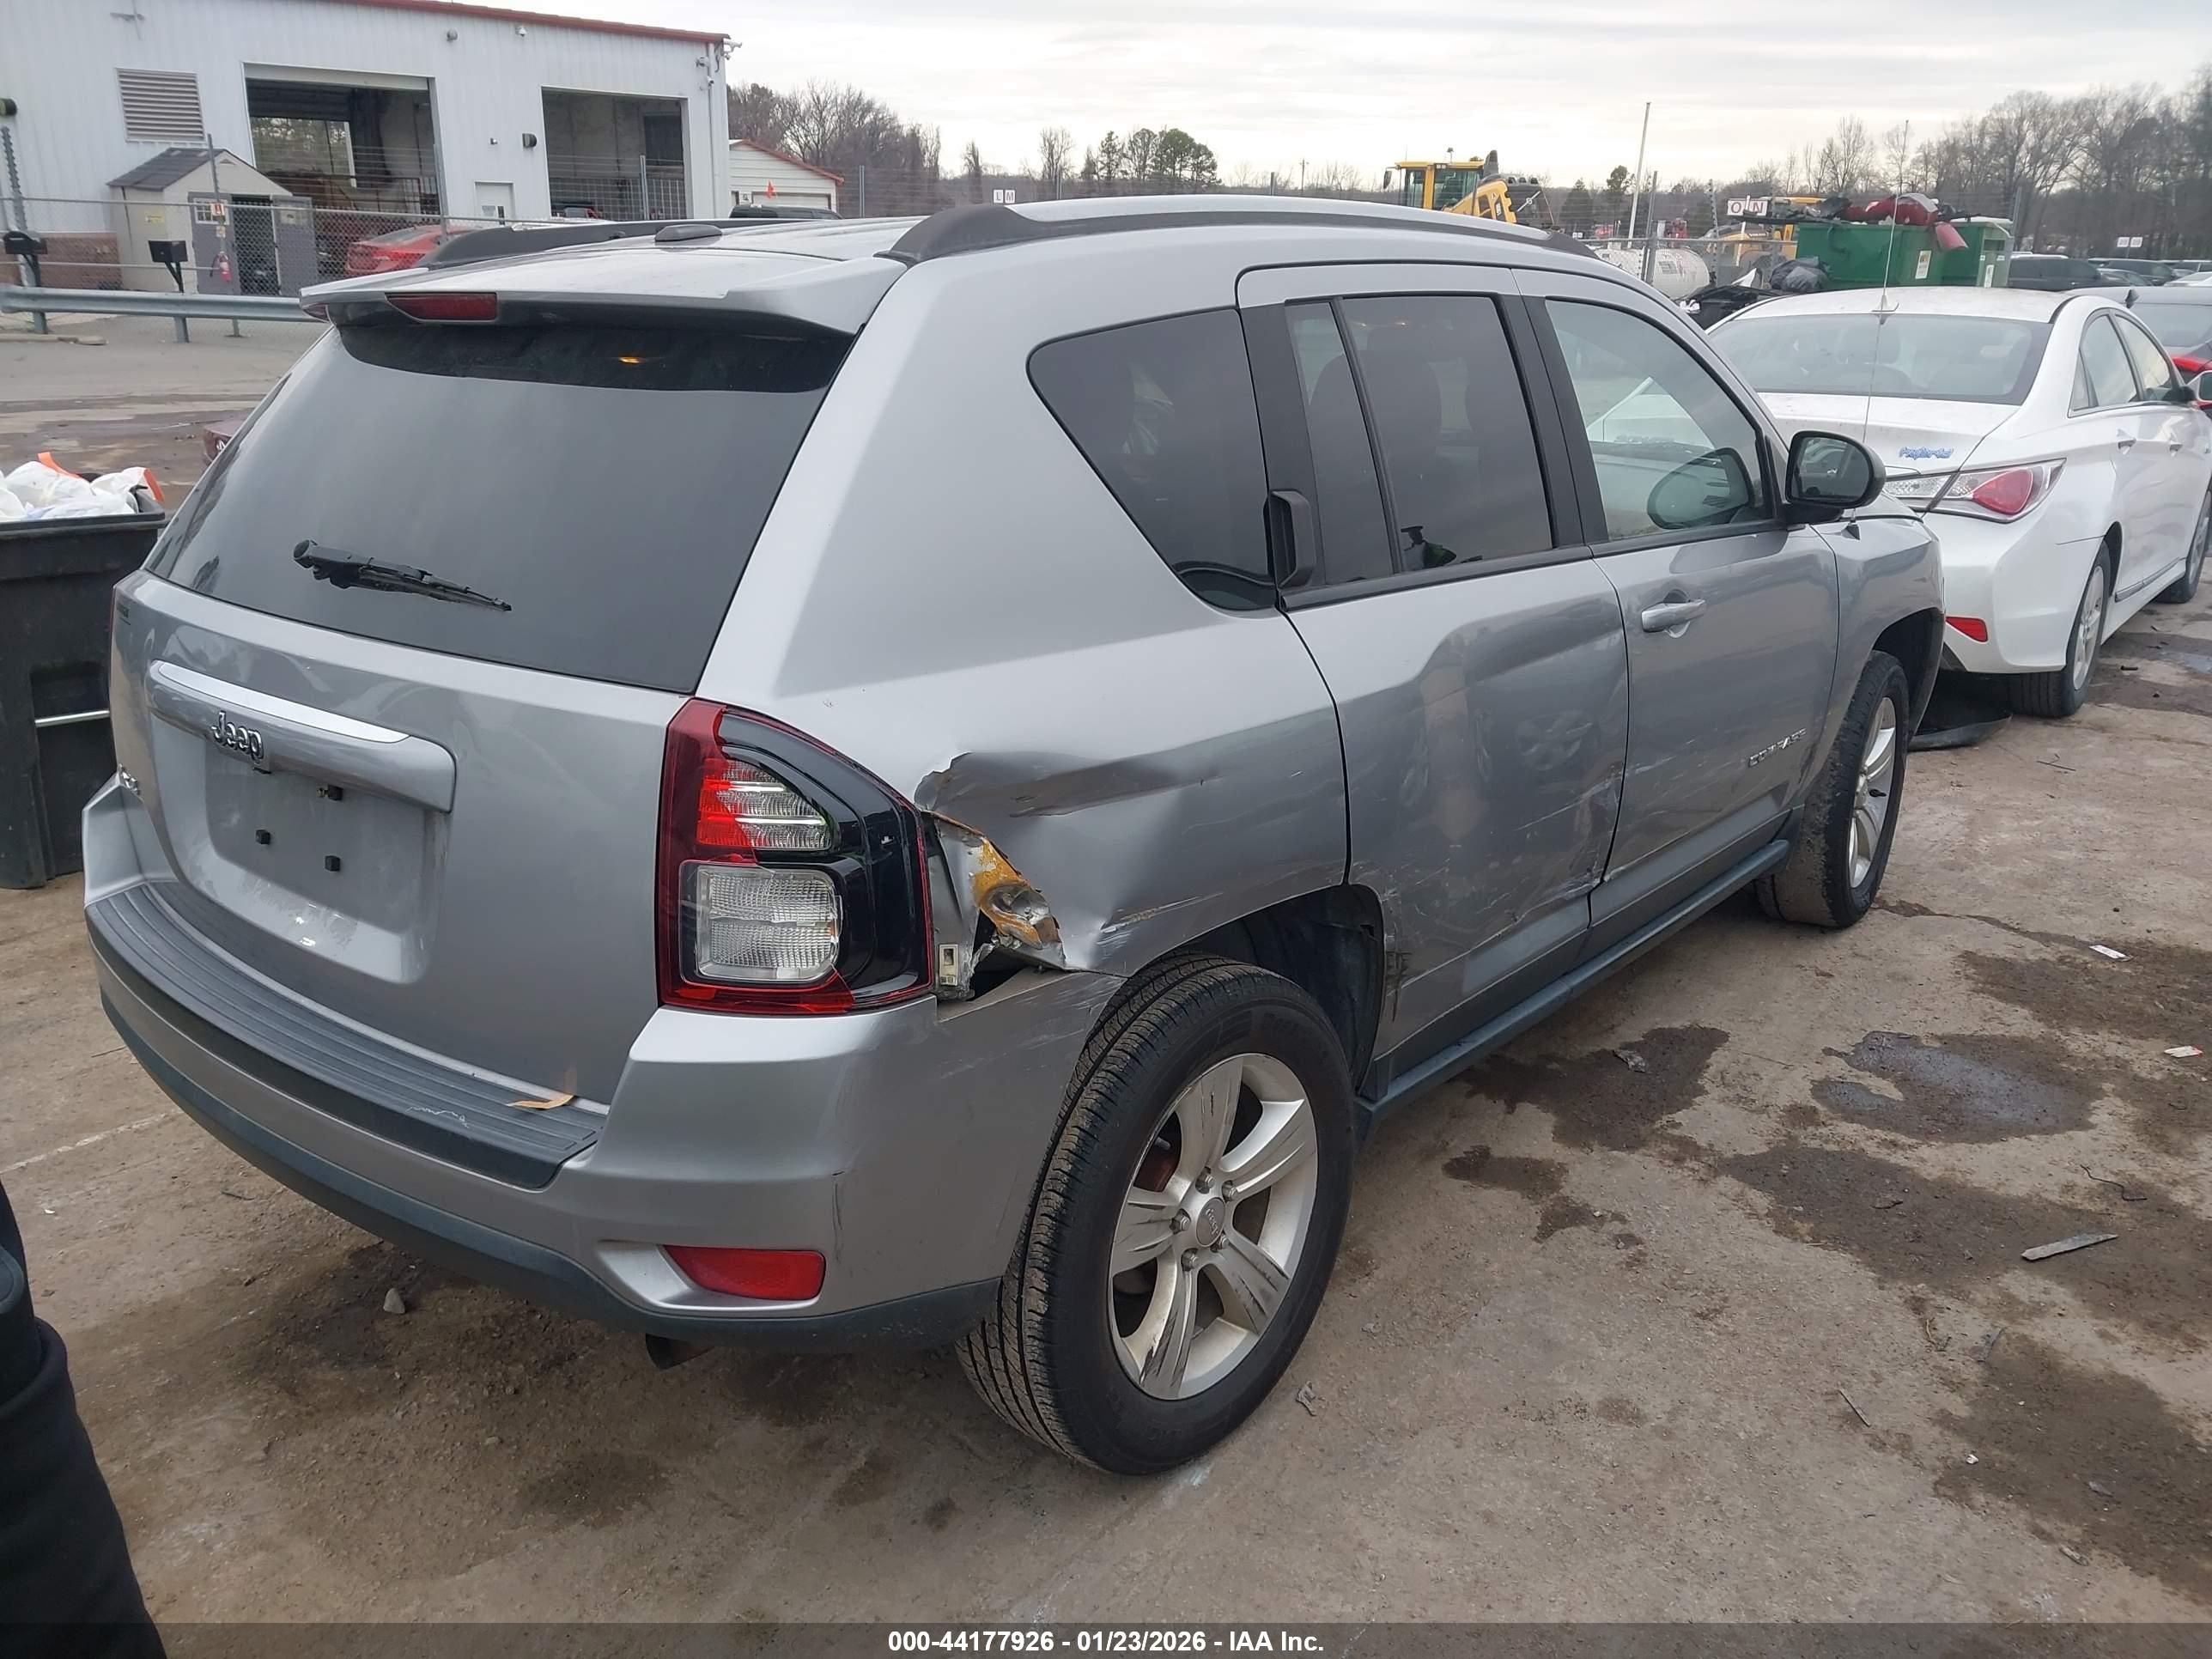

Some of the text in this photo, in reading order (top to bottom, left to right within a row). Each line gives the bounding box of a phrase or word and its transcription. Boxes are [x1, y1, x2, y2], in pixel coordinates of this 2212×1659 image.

[1730, 202, 1764, 214] O N
[210, 710, 264, 763] Jeep
